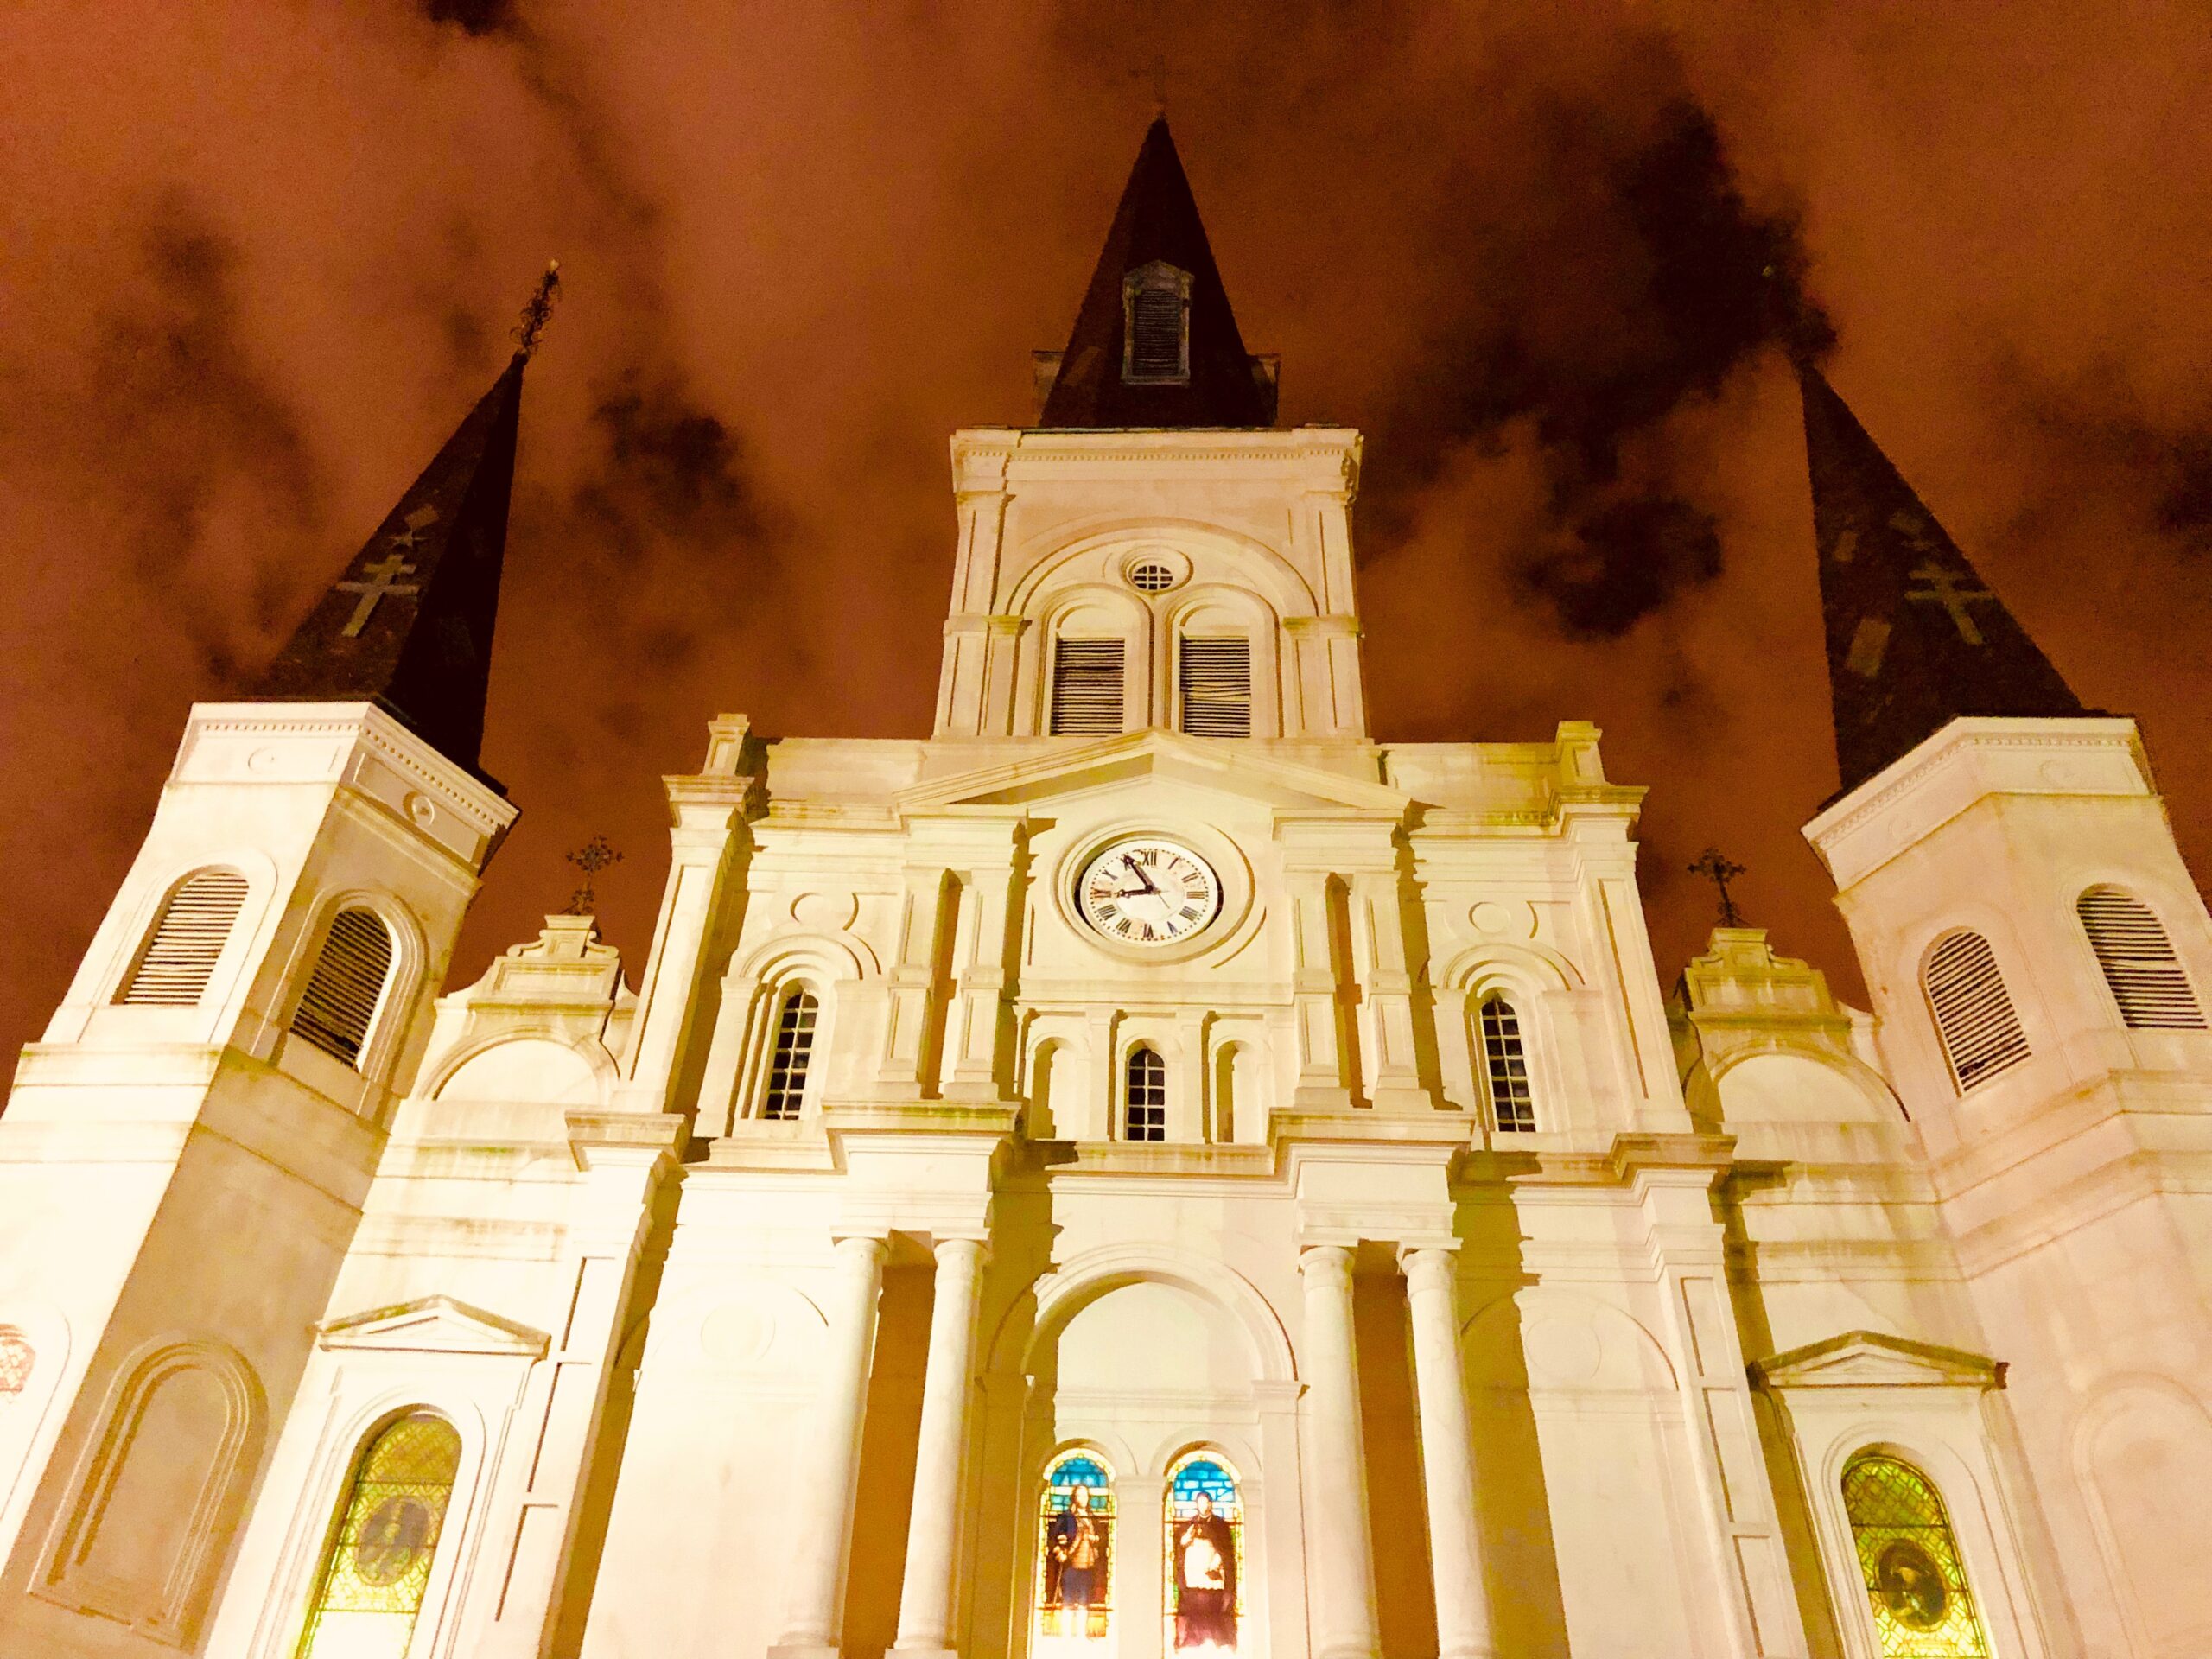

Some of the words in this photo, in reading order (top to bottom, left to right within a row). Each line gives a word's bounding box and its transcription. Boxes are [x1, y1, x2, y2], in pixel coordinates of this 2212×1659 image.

[1142, 851, 1157, 866] XII
[1167, 857, 1179, 869] I
[1101, 869, 1118, 881] X
[1181, 872, 1199, 883] II
[1186, 891, 1205, 899] III
[1115, 918, 1132, 934] VII
[1142, 923, 1154, 938] VI
[1166, 920, 1179, 934] V
